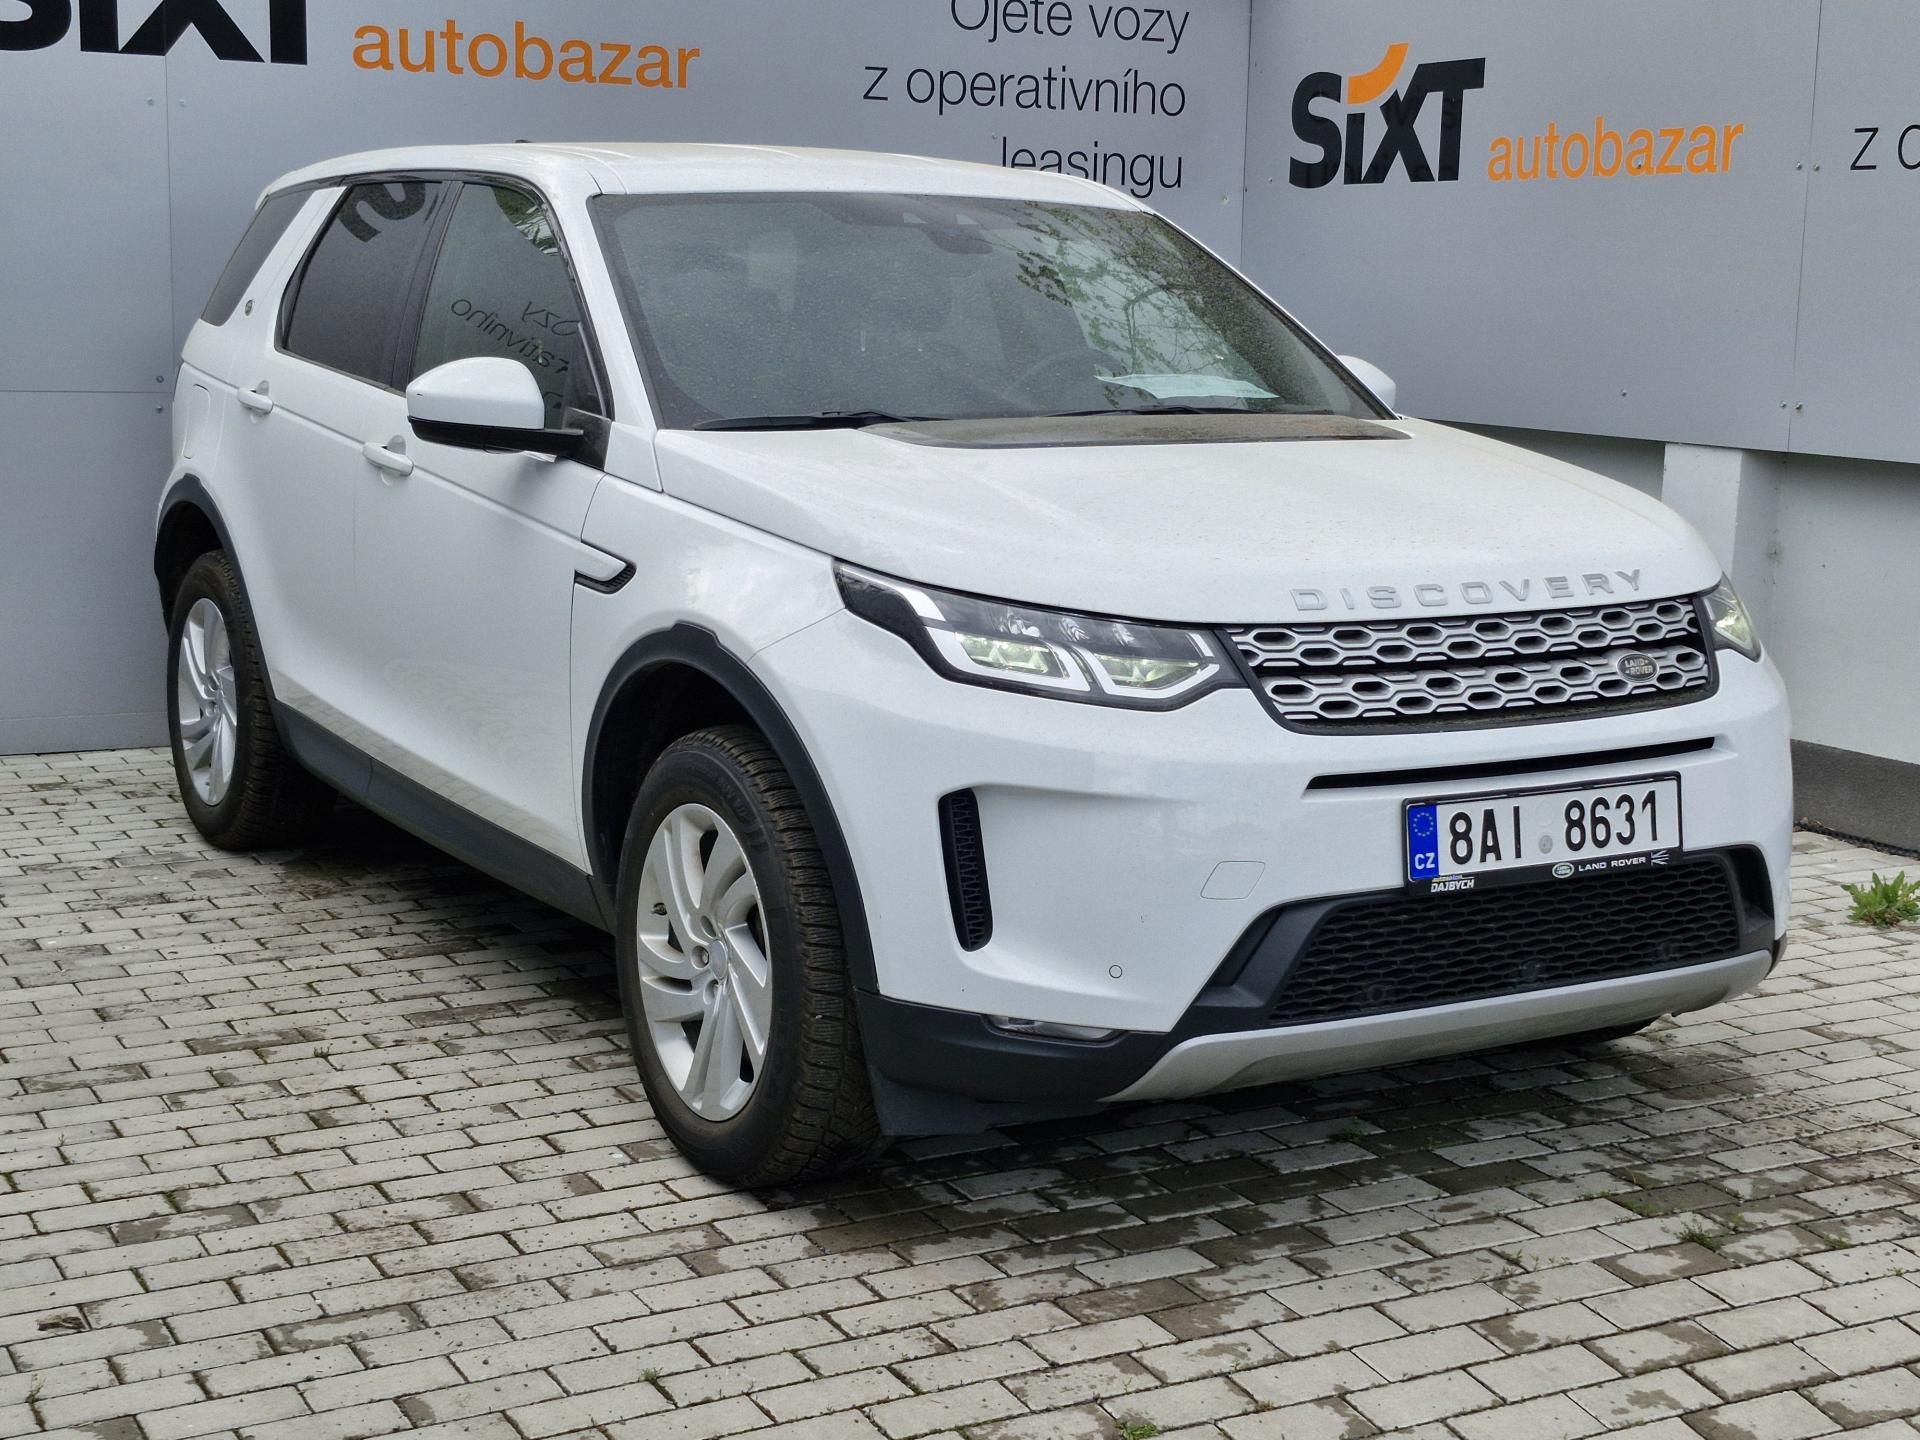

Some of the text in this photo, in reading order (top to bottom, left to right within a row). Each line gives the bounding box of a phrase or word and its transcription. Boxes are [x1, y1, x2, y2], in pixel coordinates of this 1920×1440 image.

[1089, 4, 1190, 54] vozy
[352, 20, 700, 89] autobazar
[863, 65, 1186, 117] z operativního
[1001, 136, 1182, 199] leasingu
[1487, 116, 1744, 181] autobazar
[1850, 127, 1879, 170] z
[1290, 568, 1641, 611] DISCOVERY
[1564, 789, 1659, 852] 8631
[1414, 852, 1436, 870] CZ
[1430, 878, 1475, 893] DAJBYCH
[1578, 861, 1607, 872] LAND
[1610, 856, 1647, 868] ROVER
